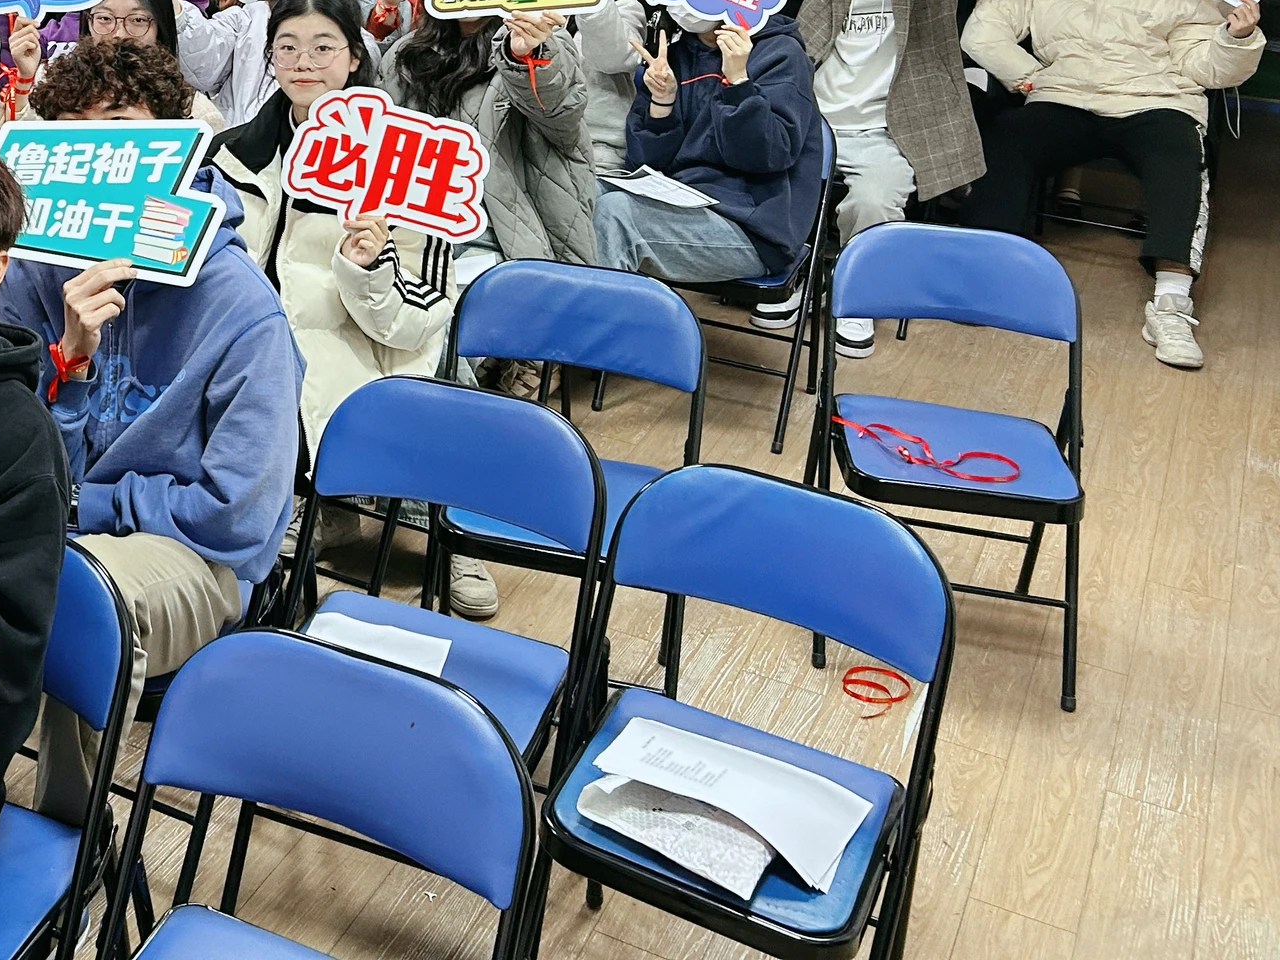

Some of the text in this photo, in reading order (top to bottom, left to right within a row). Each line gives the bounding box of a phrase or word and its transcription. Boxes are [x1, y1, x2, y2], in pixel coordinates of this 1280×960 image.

[4, 139, 182, 186] 撸起袖子
[301, 106, 470, 225] 必胜
